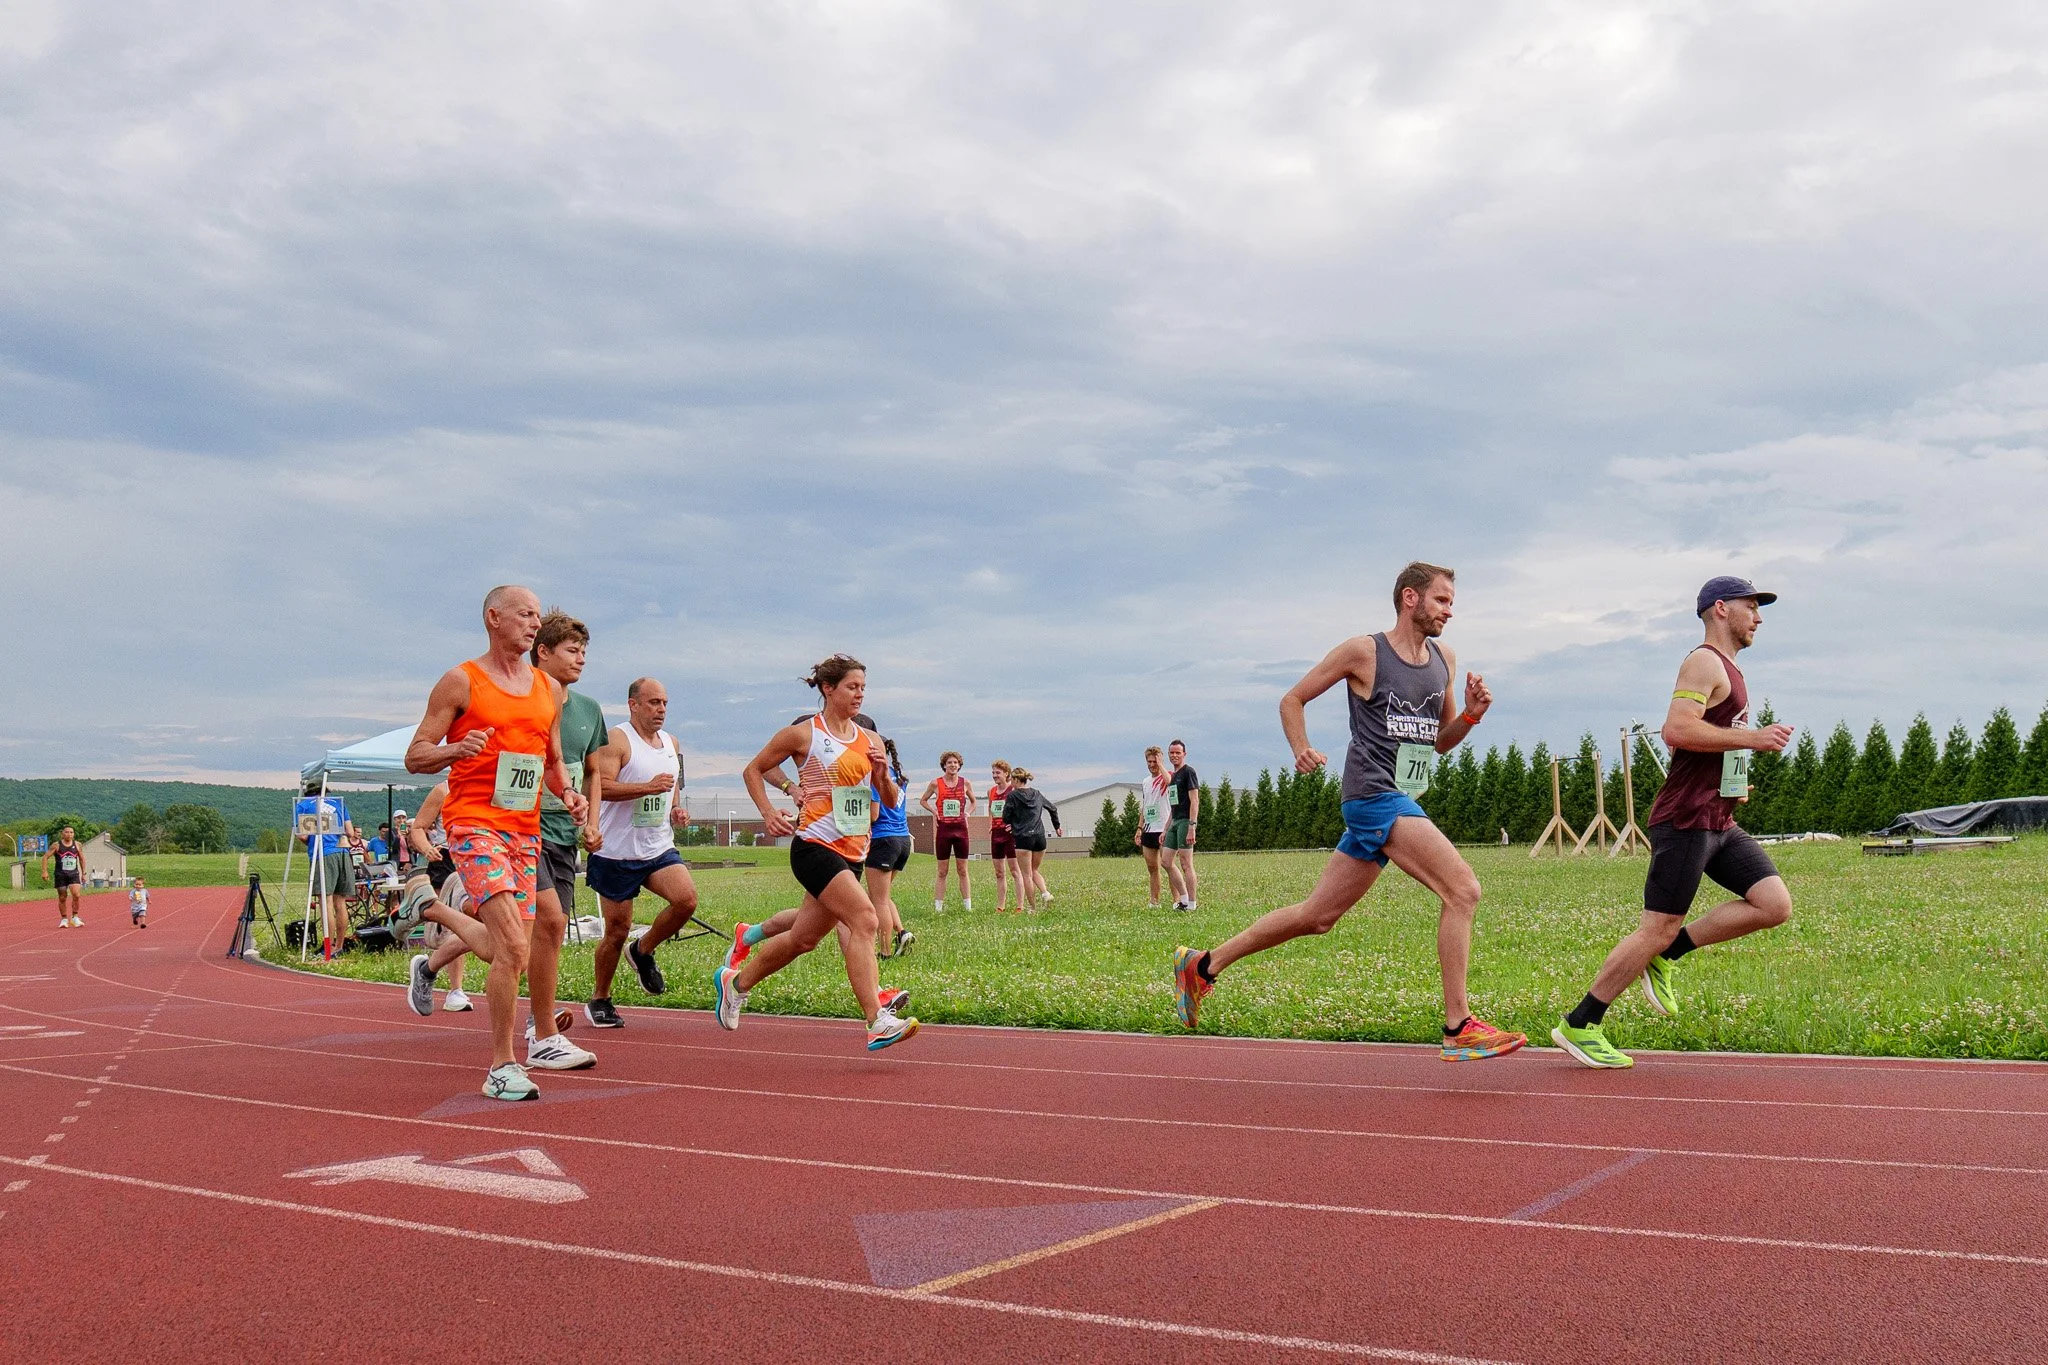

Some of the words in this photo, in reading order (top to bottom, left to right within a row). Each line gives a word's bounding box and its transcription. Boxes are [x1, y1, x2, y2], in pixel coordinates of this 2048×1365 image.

[1386, 714, 1440, 726] CHRISTIANSBUR
[1387, 721, 1417, 734] RUN
[1419, 723, 1439, 737] CLU
[510, 768, 535, 789] 703
[1407, 760, 1427, 780] 713
[643, 797, 660, 812] 616
[844, 799, 862, 817] 461
